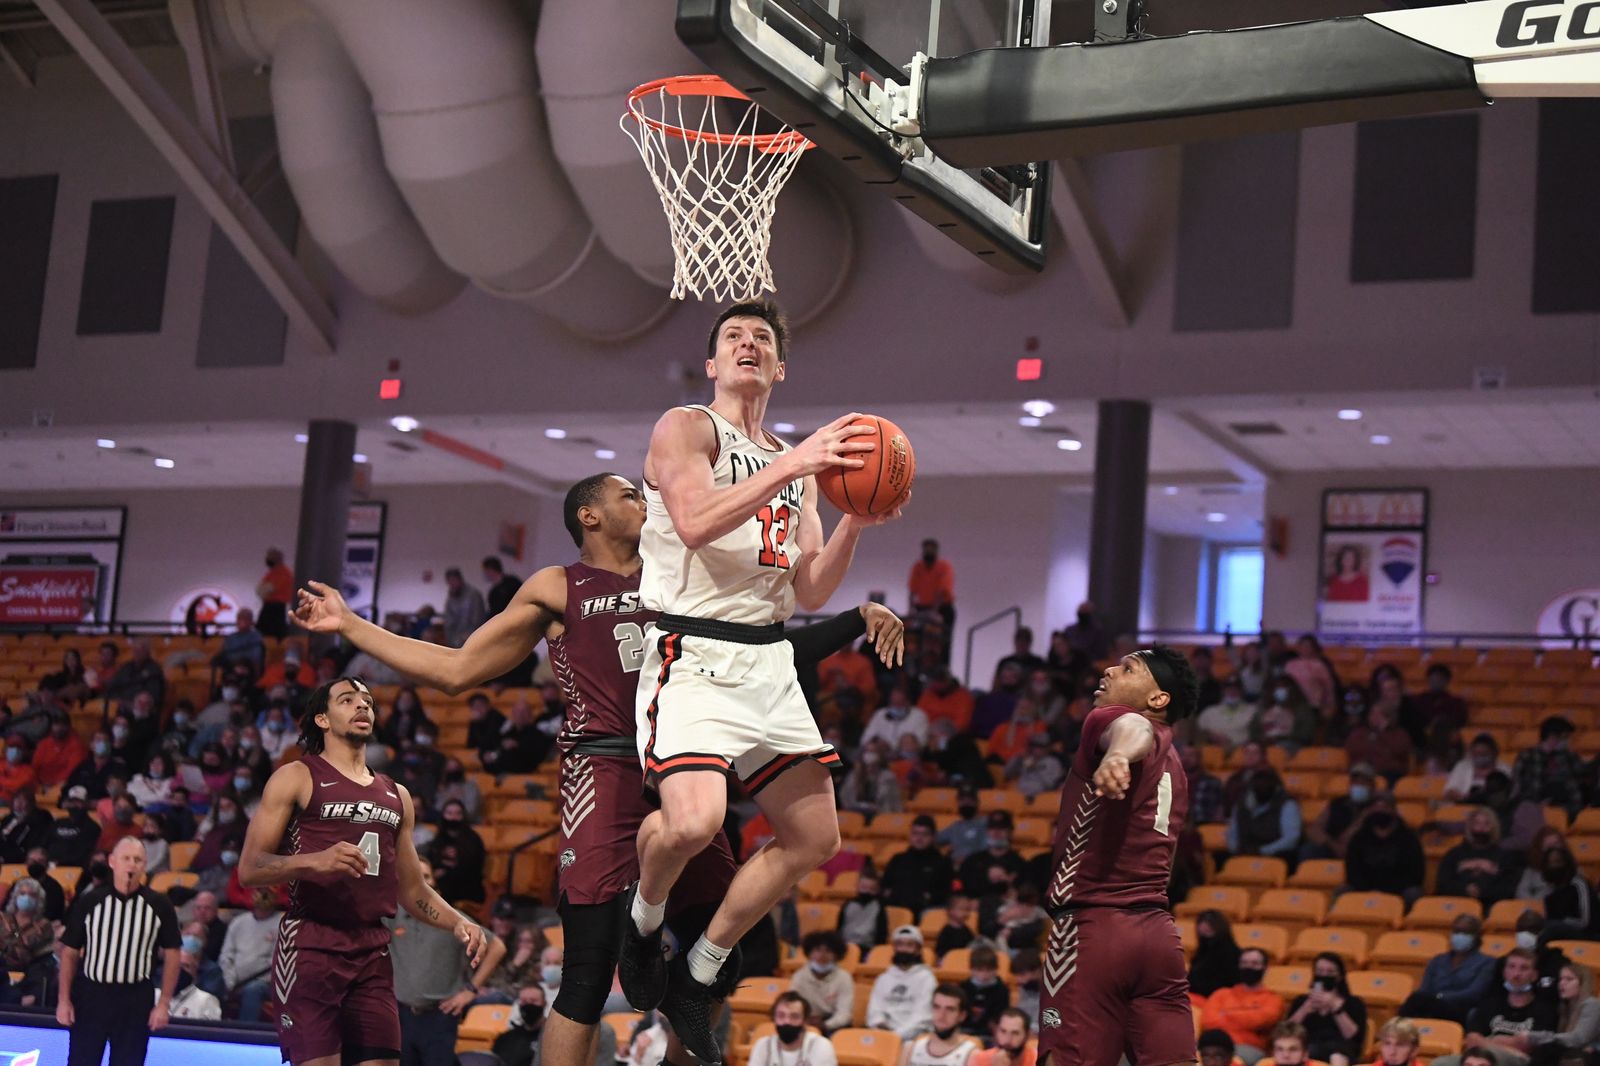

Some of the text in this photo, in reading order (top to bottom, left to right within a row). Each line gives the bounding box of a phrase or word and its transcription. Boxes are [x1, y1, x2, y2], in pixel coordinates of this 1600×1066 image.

[756, 504, 790, 569] 12
[582, 597, 618, 618] THE
[613, 621, 657, 673] 2
[321, 802, 401, 828] THE SHORE
[1153, 772, 1172, 836] 1
[357, 831, 381, 876] 4
